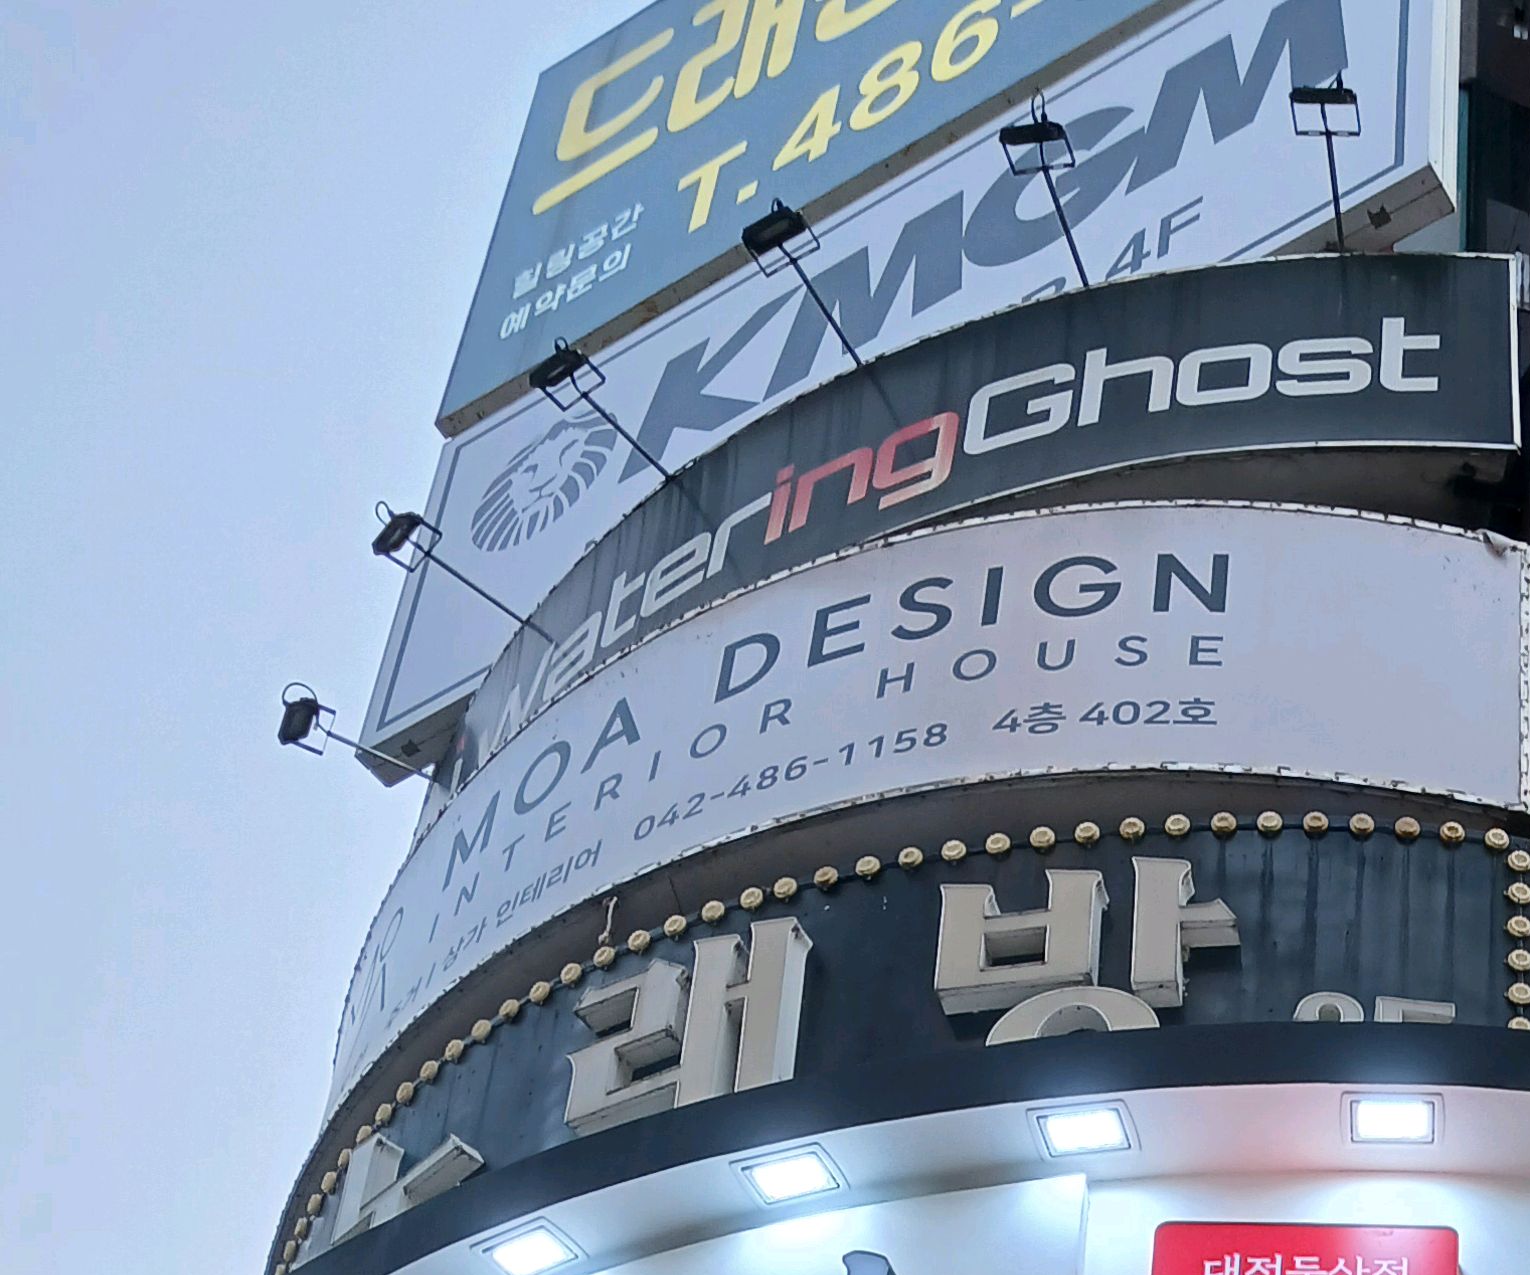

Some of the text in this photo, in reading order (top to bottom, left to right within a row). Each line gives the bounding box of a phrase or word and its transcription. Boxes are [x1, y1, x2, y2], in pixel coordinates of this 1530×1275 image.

[532, 0, 899, 216] 드래
[500, 243, 632, 340] 예약문의
[428, 698, 792, 943] INTERIOR
[876, 634, 1225, 699] HOUSE
[442, 553, 1231, 892] MOA DESIGN
[496, 840, 602, 928] 인테리어
[633, 722, 948, 841] 042-486-1158
[992, 702, 1067, 735] 4층
[1079, 697, 1218, 727] 402호
